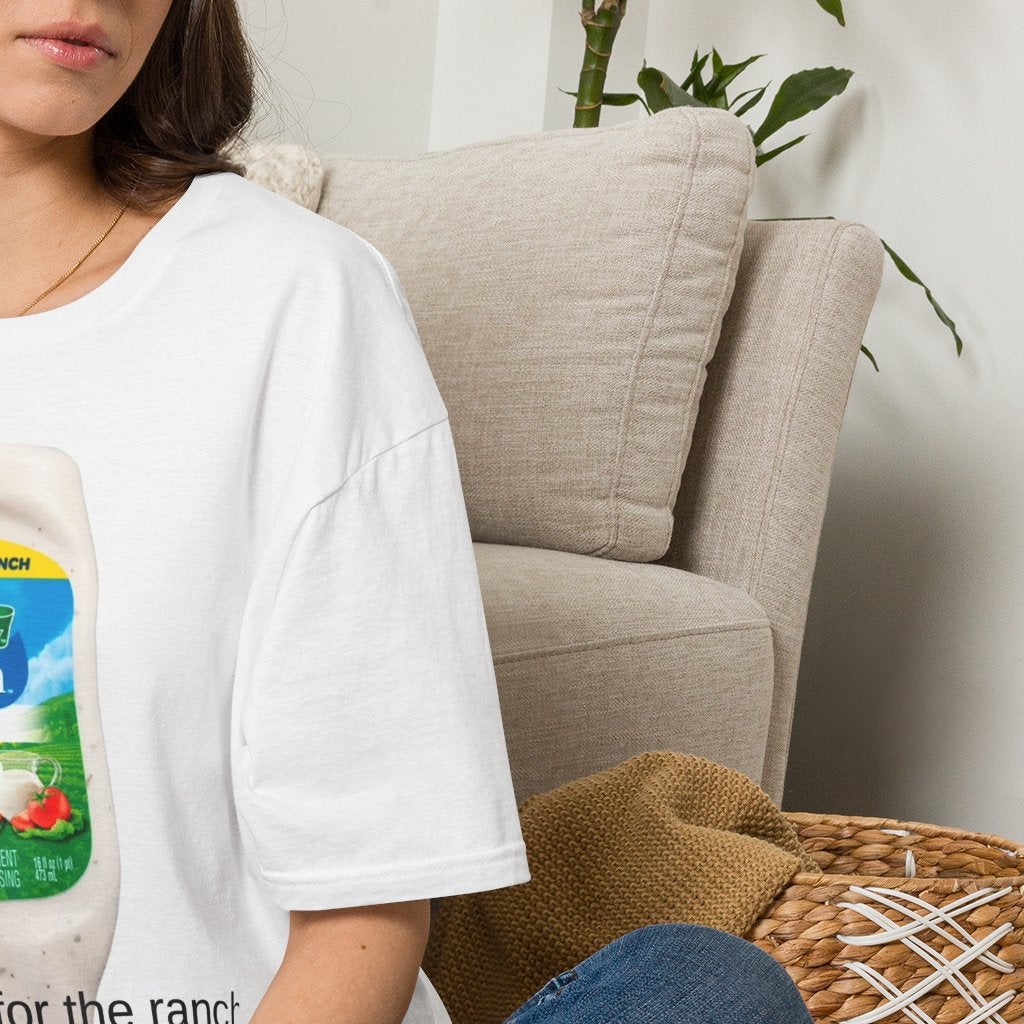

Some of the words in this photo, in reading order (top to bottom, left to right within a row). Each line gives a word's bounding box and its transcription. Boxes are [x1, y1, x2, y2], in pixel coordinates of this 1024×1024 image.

[33, 855, 42, 869] 16
[48, 859, 56, 870] oz
[35, 869, 47, 882] 473
